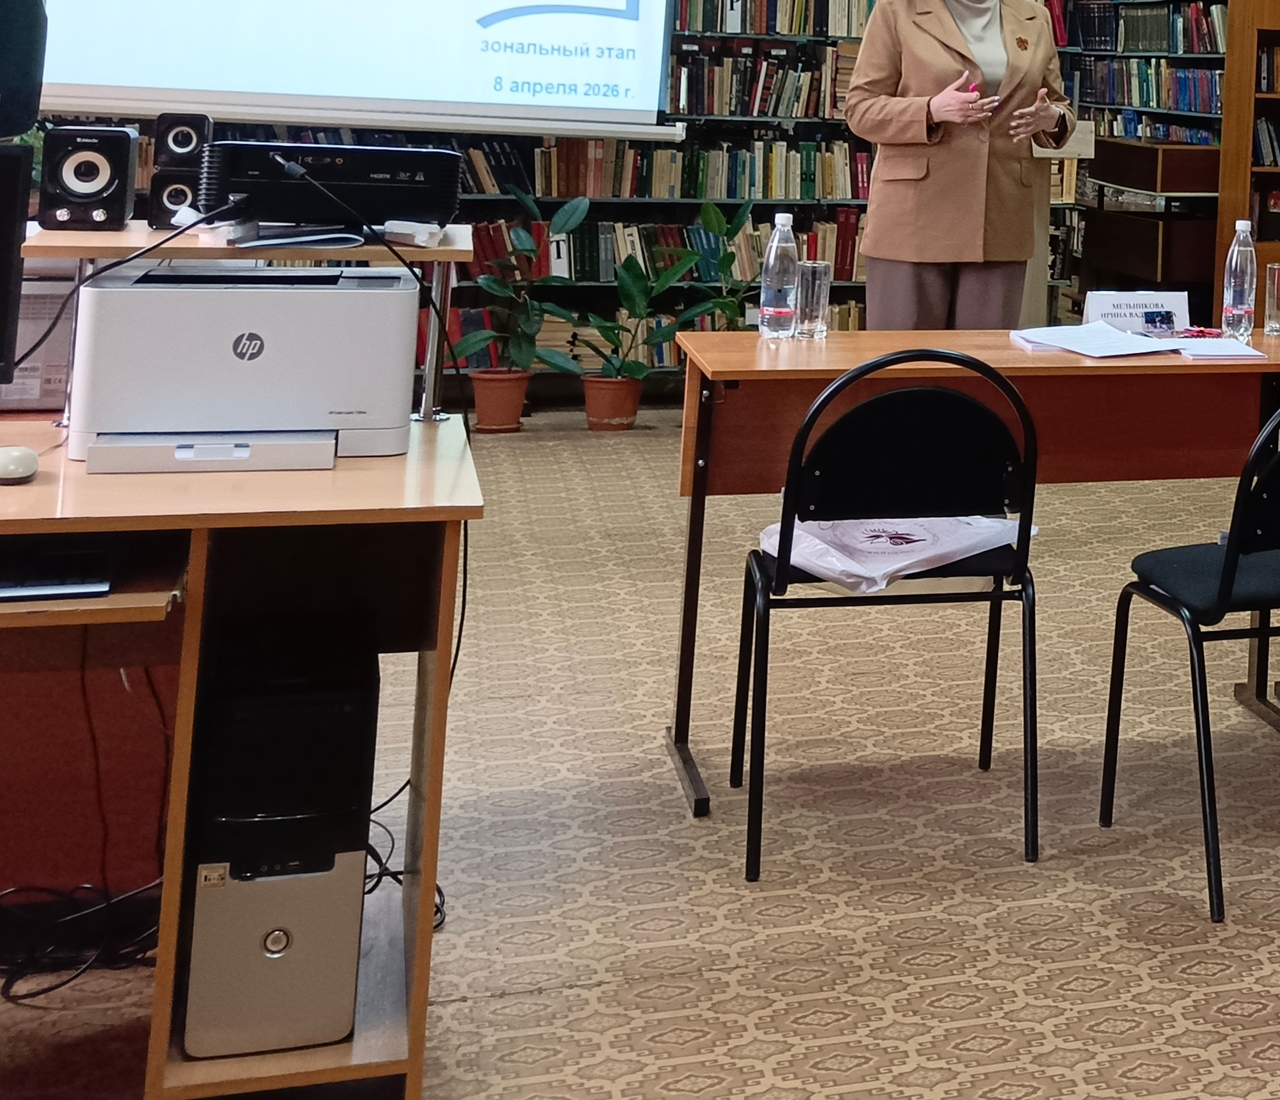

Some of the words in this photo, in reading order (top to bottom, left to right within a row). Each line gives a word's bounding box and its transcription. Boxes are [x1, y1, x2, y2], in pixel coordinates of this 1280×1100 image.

[480, 40, 590, 58] зональный
[595, 45, 636, 60] этап
[493, 76, 503, 92] 8
[509, 79, 578, 97] апреля
[583, 82, 620, 98] 2026
[624, 86, 636, 99] г.
[549, 239, 566, 259] Т
[1100, 311, 1128, 319] ИРИНА
[1112, 302, 1165, 310] МЕЛЬНИКОВА
[235, 332, 263, 361] hp
